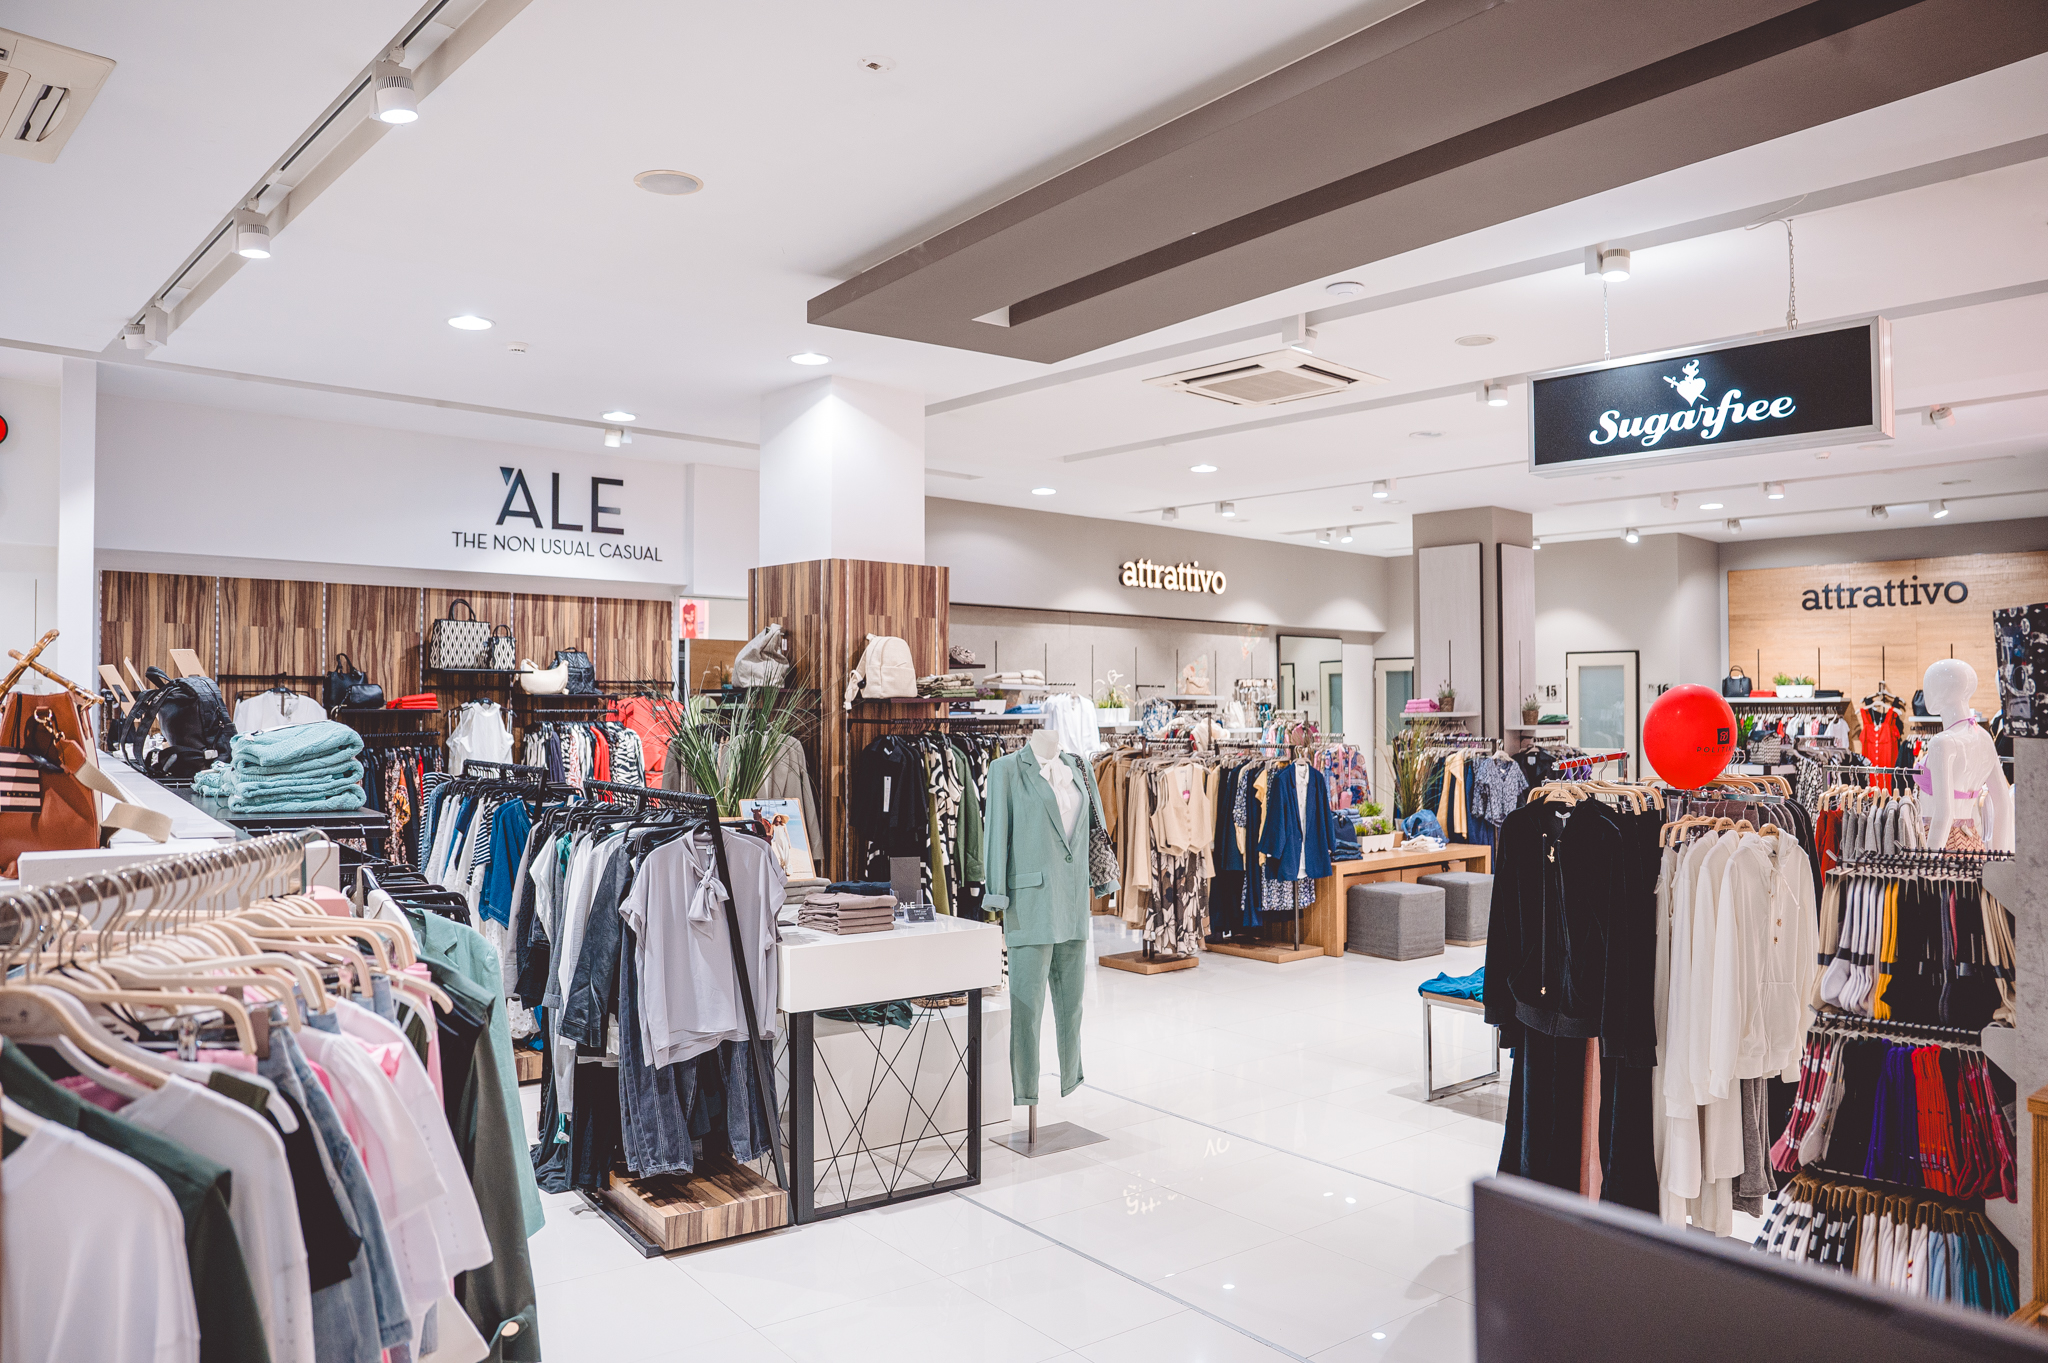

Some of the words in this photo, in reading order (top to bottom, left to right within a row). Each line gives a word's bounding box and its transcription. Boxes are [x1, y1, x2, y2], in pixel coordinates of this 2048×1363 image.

[452, 531, 488, 549] THE
[493, 534, 535, 553] NON
[541, 538, 595, 558] USUAL
[599, 543, 663, 562] CASUAL
[1120, 557, 1227, 595] attrattivo
[1801, 575, 1969, 611] attrattivo
[1545, 684, 1558, 697] 15
